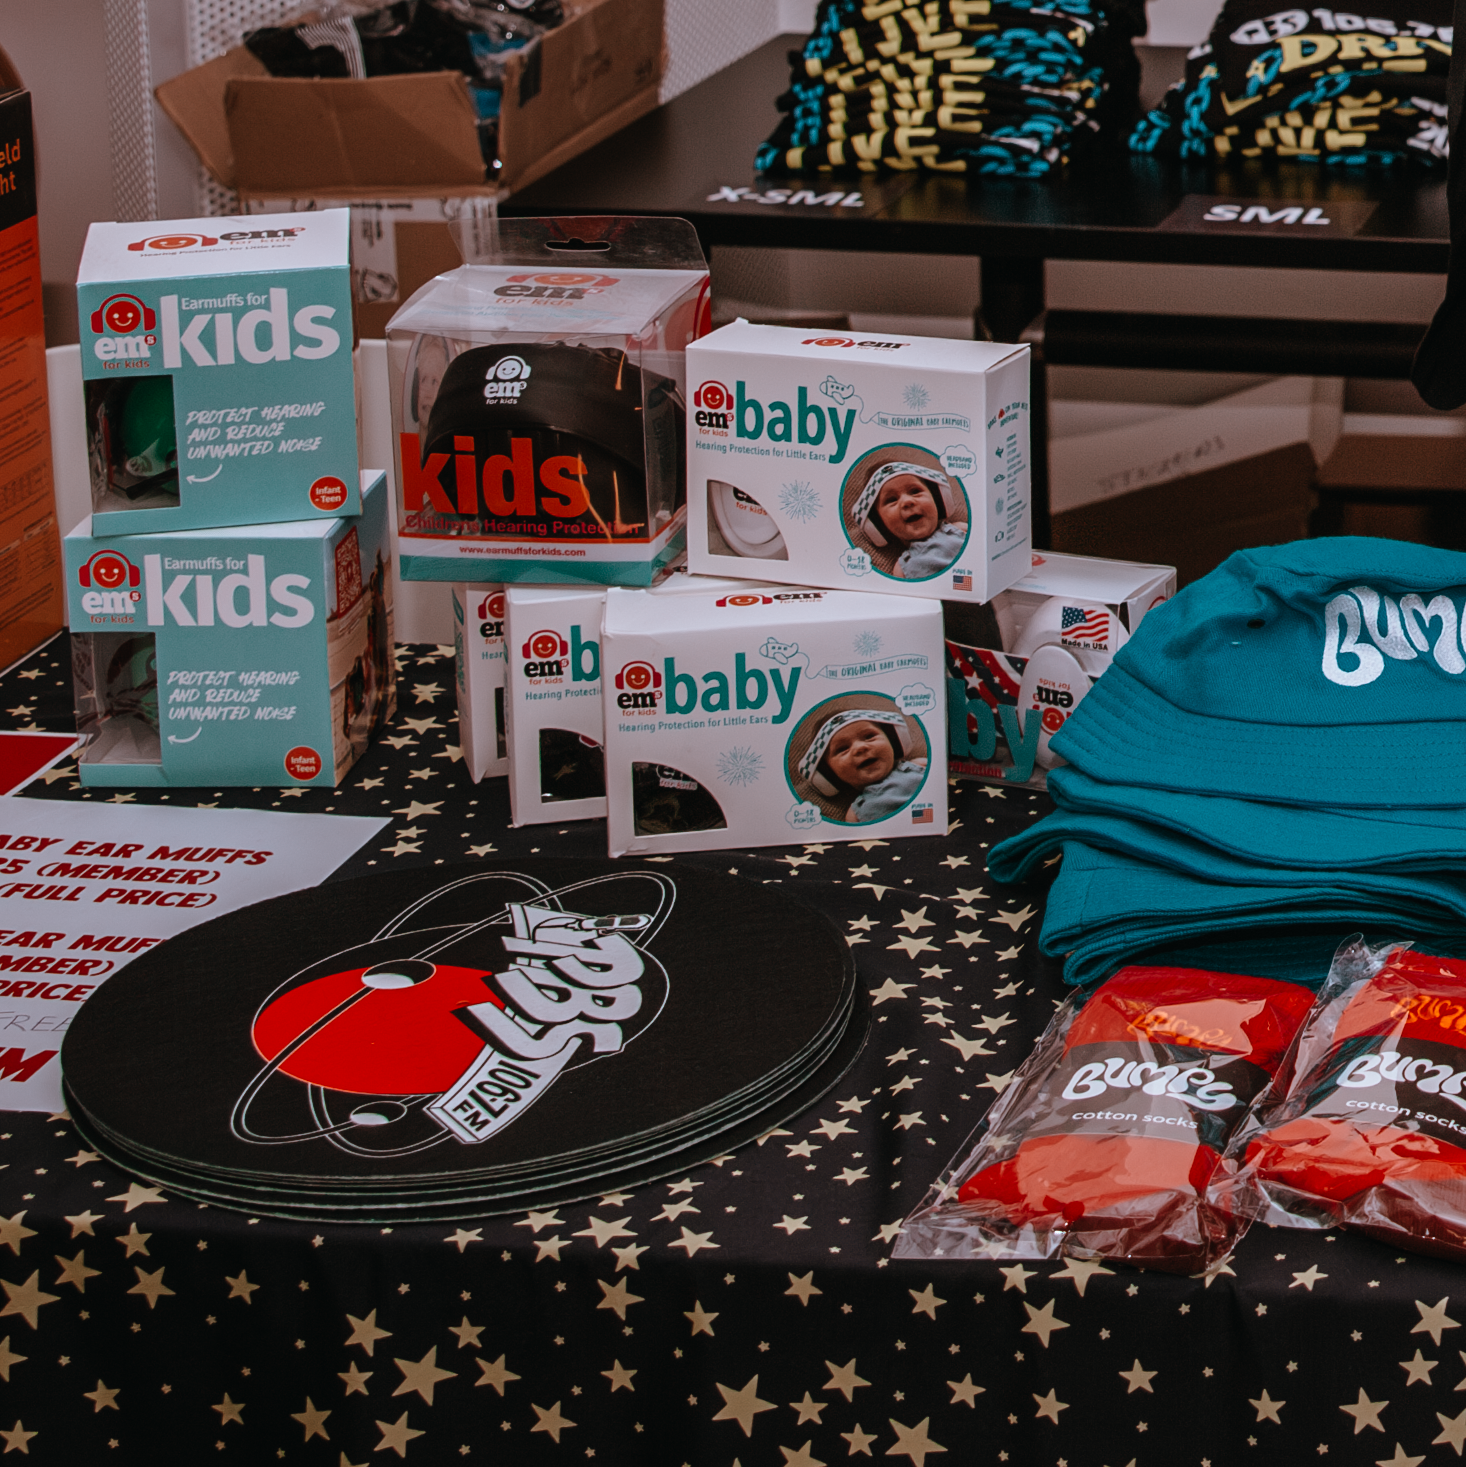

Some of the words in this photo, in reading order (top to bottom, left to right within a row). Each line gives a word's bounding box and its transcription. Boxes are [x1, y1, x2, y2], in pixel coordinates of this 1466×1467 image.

[705, 185, 866, 208] X-SML
[1203, 204, 1331, 225] SML
[180, 294, 245, 310] Earmuffs
[246, 292, 268, 307] for
[159, 287, 341, 369] kids
[102, 359, 123, 370] for
[124, 358, 150, 369] kids
[186, 406, 258, 426] PROTECT
[260, 401, 326, 421] HEARING
[735, 379, 858, 465] baby
[187, 426, 222, 445] AND
[224, 421, 286, 440] REDUCE
[187, 441, 274, 461] UNWANTED
[277, 436, 323, 454] NOISE
[695, 439, 727, 454] Hearing
[729, 443, 771, 457] Protection
[772, 446, 784, 458] for
[786, 448, 807, 460] Little
[809, 451, 826, 462] Ears
[399, 432, 591, 519] kids
[315, 485, 342, 496] Infant
[320, 494, 342, 504] Teen
[484, 518, 548, 536] Hearing
[459, 545, 587, 558] www.earmuffsforkids.com
[164, 557, 224, 571] Earmuffs
[225, 557, 246, 570] for
[143, 553, 316, 629] kids
[90, 614, 110, 624] for
[110, 614, 135, 625] kids
[1060, 638, 1082, 648] Made
[1083, 640, 1091, 649] in
[1092, 641, 1109, 651] USA
[166, 670, 236, 686] PROTECT
[238, 670, 301, 686] HEARING
[544, 677, 564, 685] kids
[168, 688, 200, 705] AND
[204, 688, 262, 703] REDUCE
[525, 690, 562, 701] Hearing
[663, 651, 802, 725] baby
[168, 706, 251, 722] UNWANTED
[254, 705, 297, 721] NOISE
[622, 708, 636, 717] for
[637, 708, 657, 716] kids
[618, 723, 656, 734] Hearing
[658, 720, 706, 731] Protection
[708, 717, 721, 728] for
[723, 715, 747, 727] Little
[749, 714, 769, 724] Ears
[290, 755, 317, 765] Infant
[295, 764, 317, 774] Teen
[64, 840, 145, 860] EAR
[147, 846, 274, 866] MUFFS
[36, 862, 221, 886] (MEMBER)
[93, 887, 218, 909] PRICE)
[1344, 1098, 1411, 1117] cotton
[1071, 1109, 1138, 1122] cotton
[1141, 1113, 1199, 1129] socks
